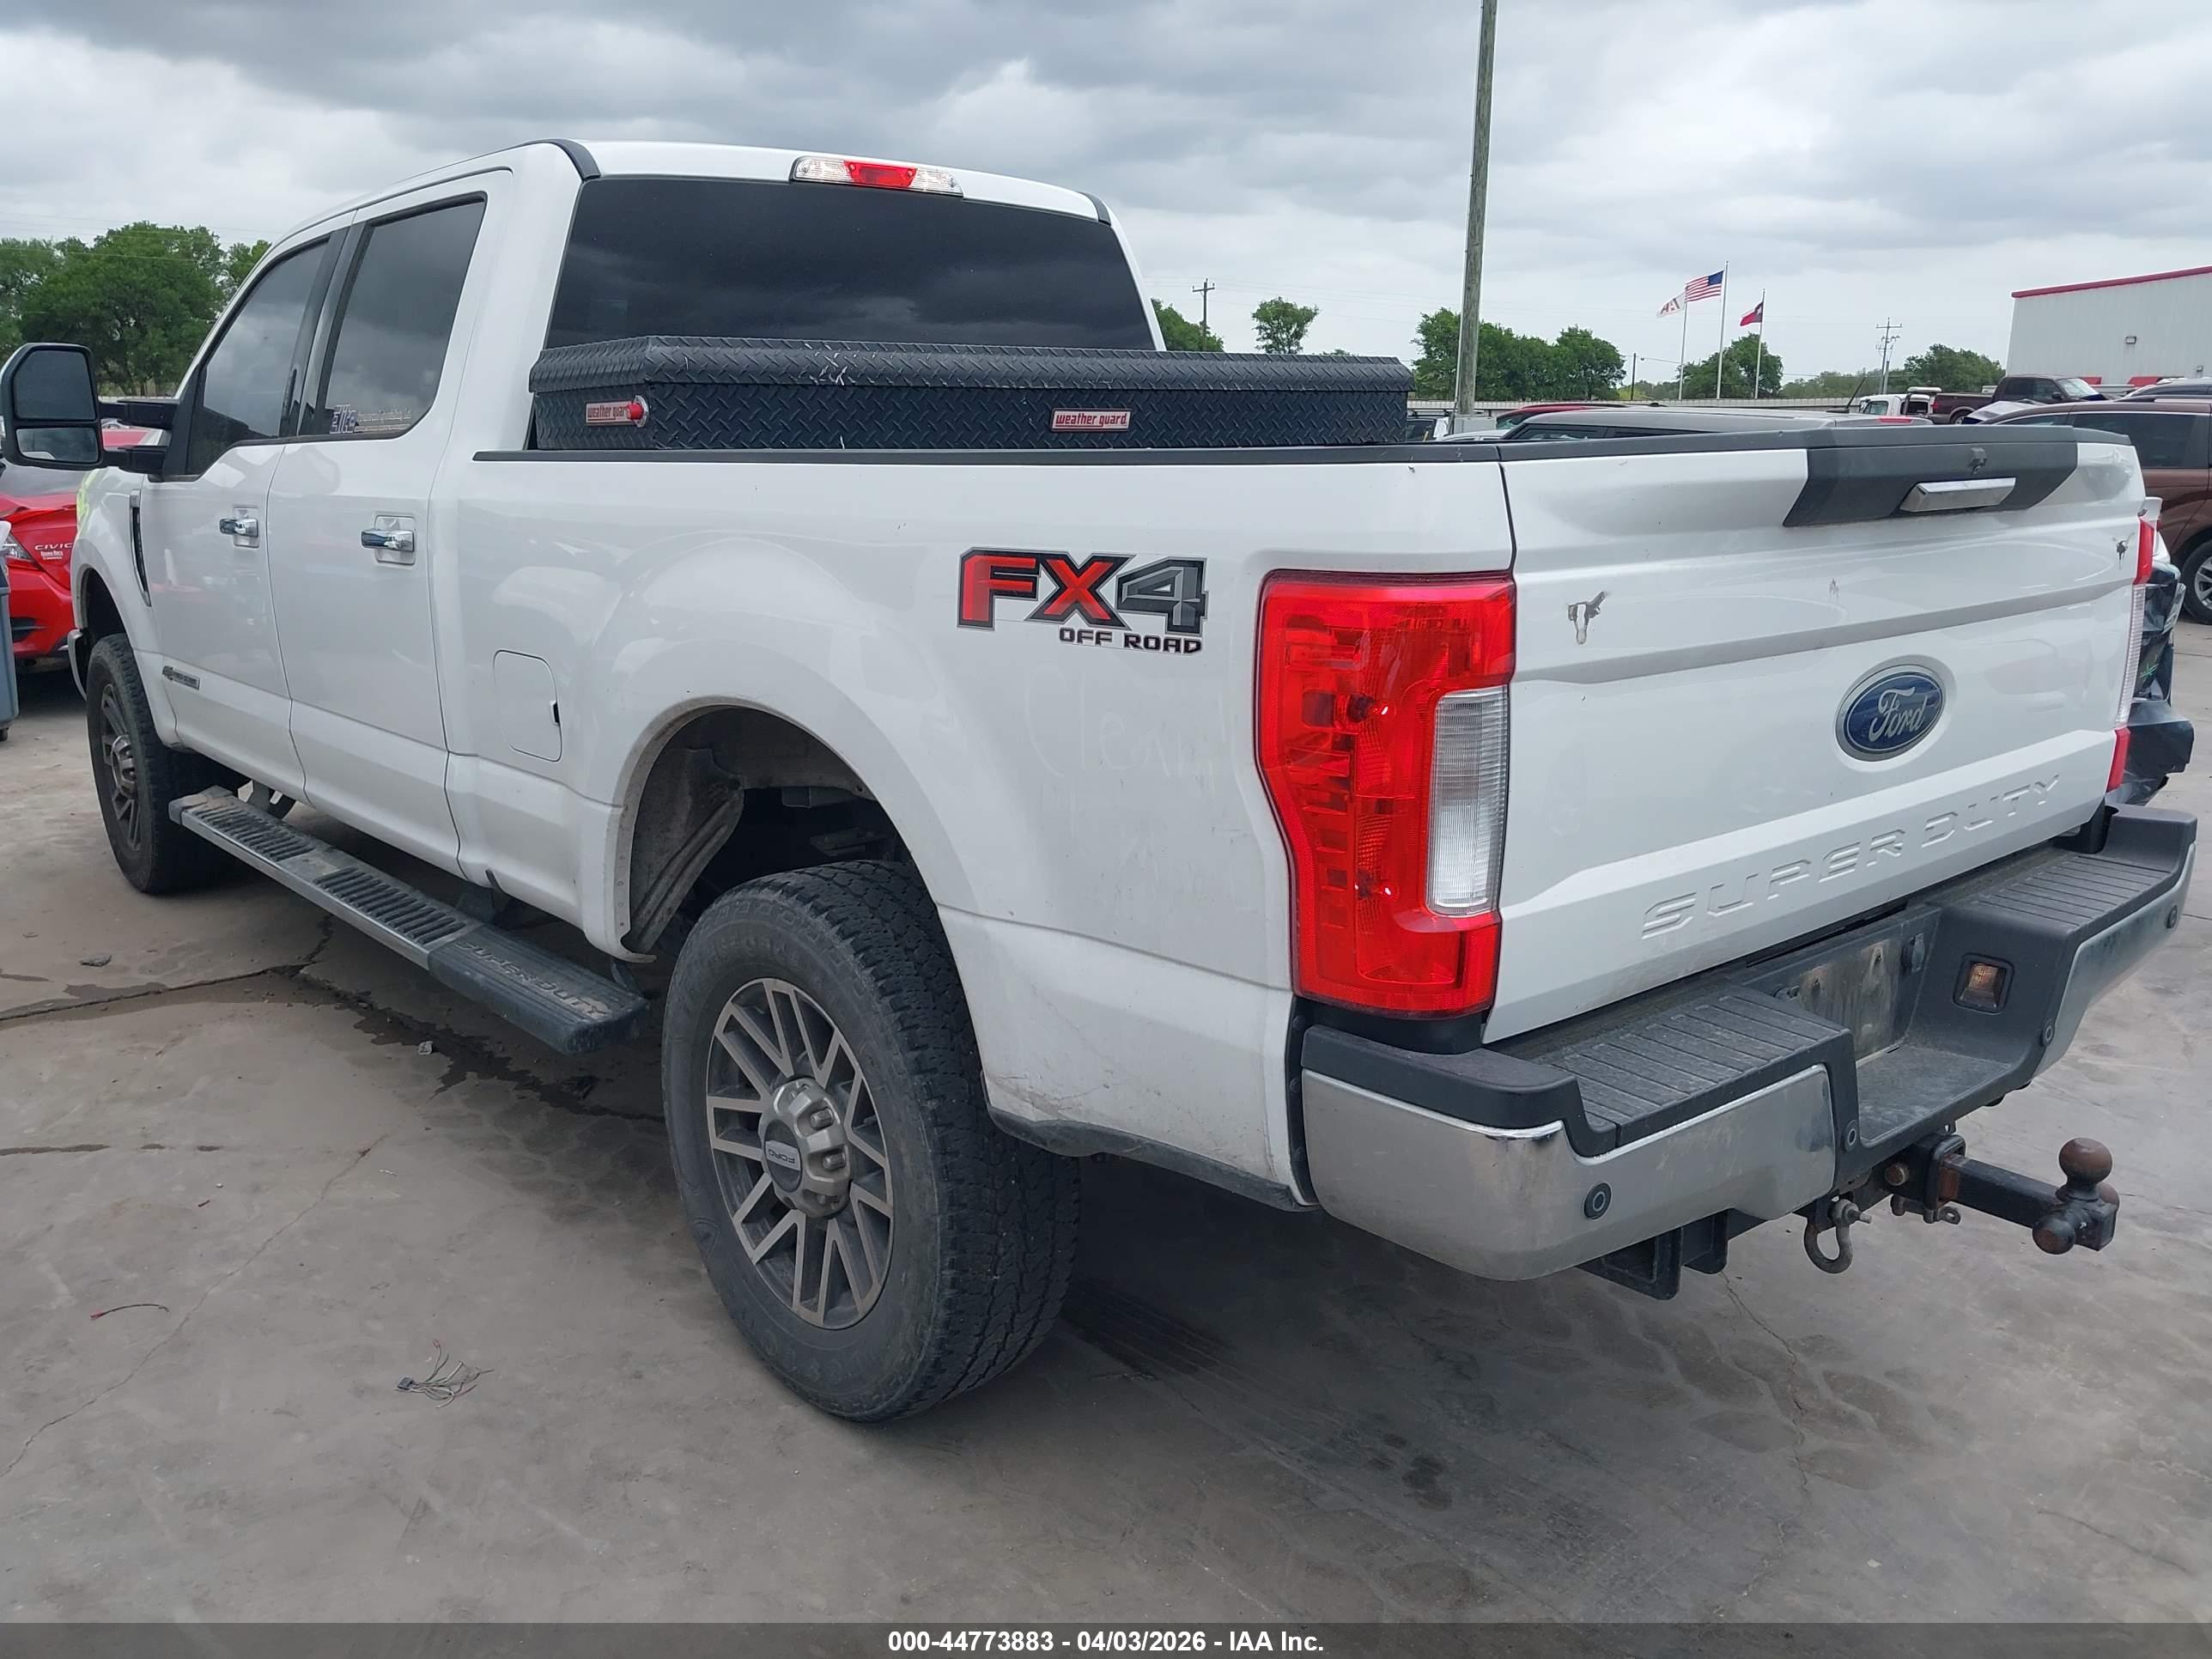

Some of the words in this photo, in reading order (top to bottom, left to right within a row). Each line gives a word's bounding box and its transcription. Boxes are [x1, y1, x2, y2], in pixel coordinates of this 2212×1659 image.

[1055, 412, 1097, 425] weather
[1098, 413, 1127, 428] guard
[34, 542, 74, 550] CIVIC
[957, 547, 1208, 637] FX4
[1059, 627, 1113, 646] OFF
[1123, 632, 1202, 654] ROAD
[1869, 686, 1927, 743] Ford
[1641, 828, 1906, 940] SUPER
[1921, 774, 2060, 848] DUTY
